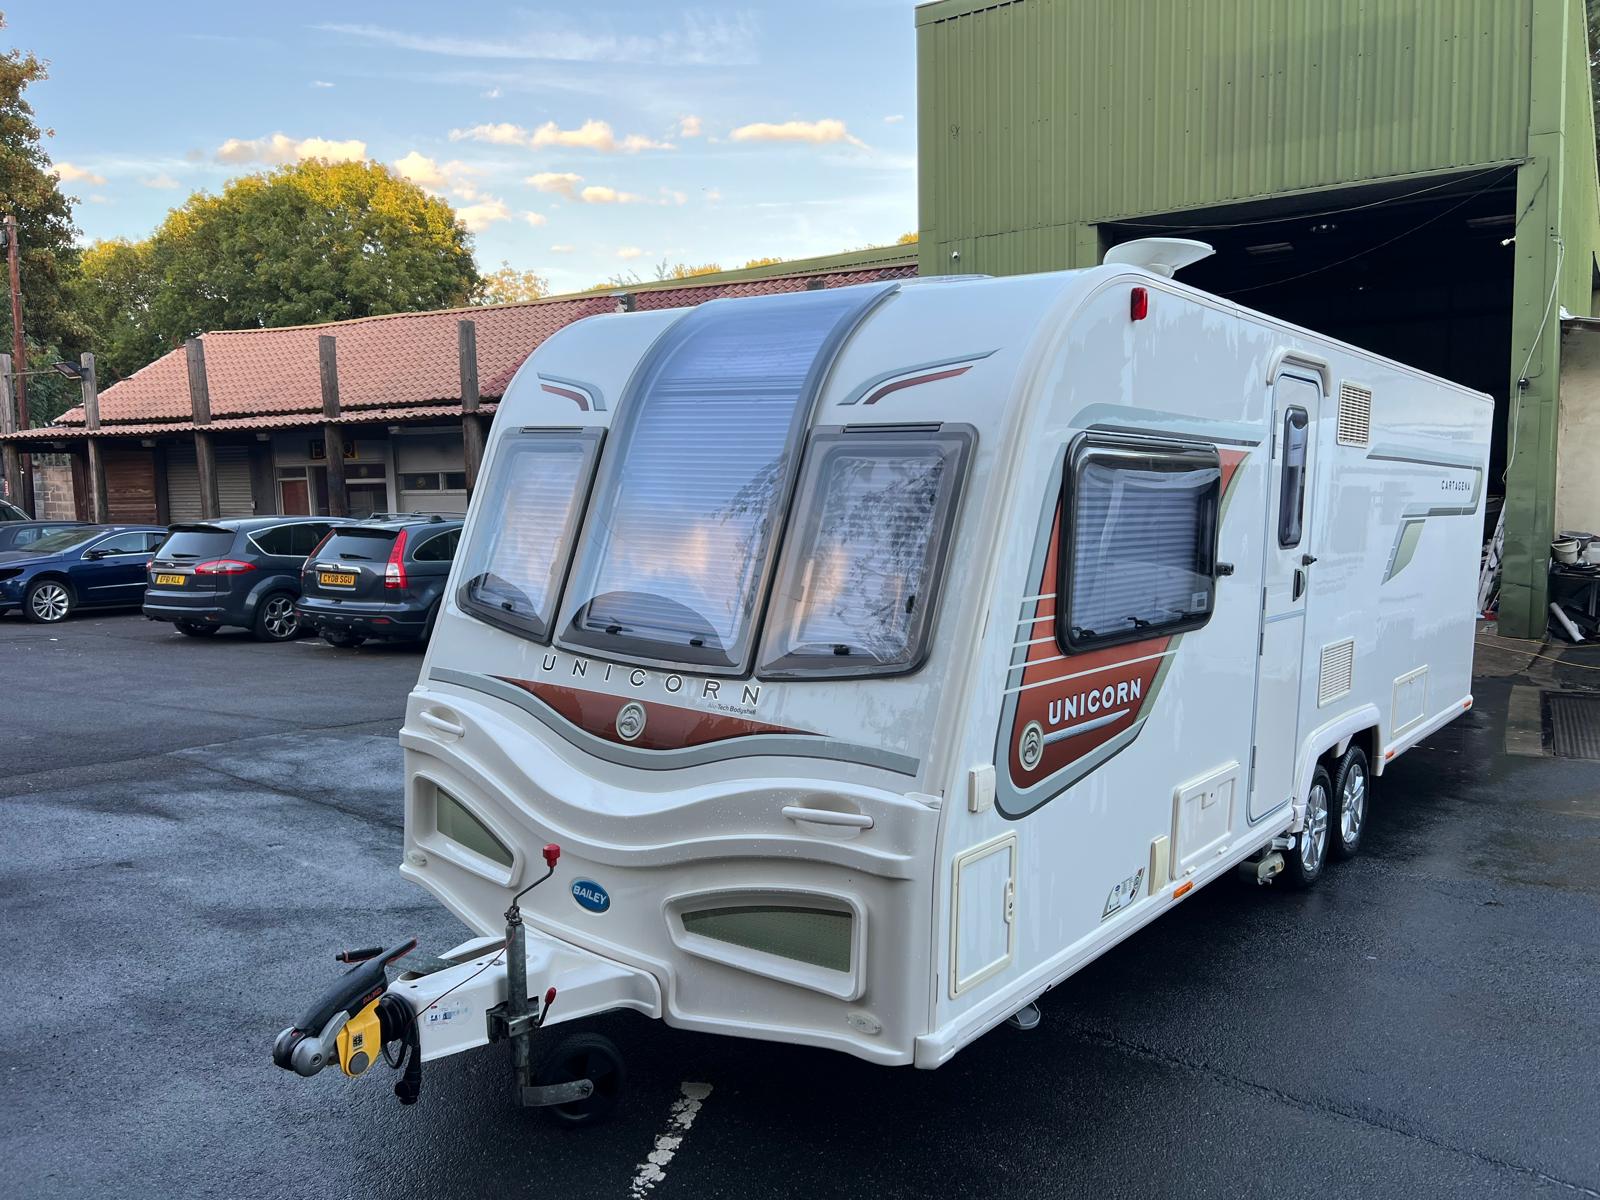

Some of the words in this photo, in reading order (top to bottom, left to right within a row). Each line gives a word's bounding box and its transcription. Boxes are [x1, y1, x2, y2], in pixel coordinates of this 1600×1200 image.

[323, 574, 339, 583] CY08
[340, 576, 353, 584] SGU
[542, 654, 760, 706] UNICORN
[1048, 678, 1142, 725] UNICORN
[573, 885, 607, 905] BAILEY
